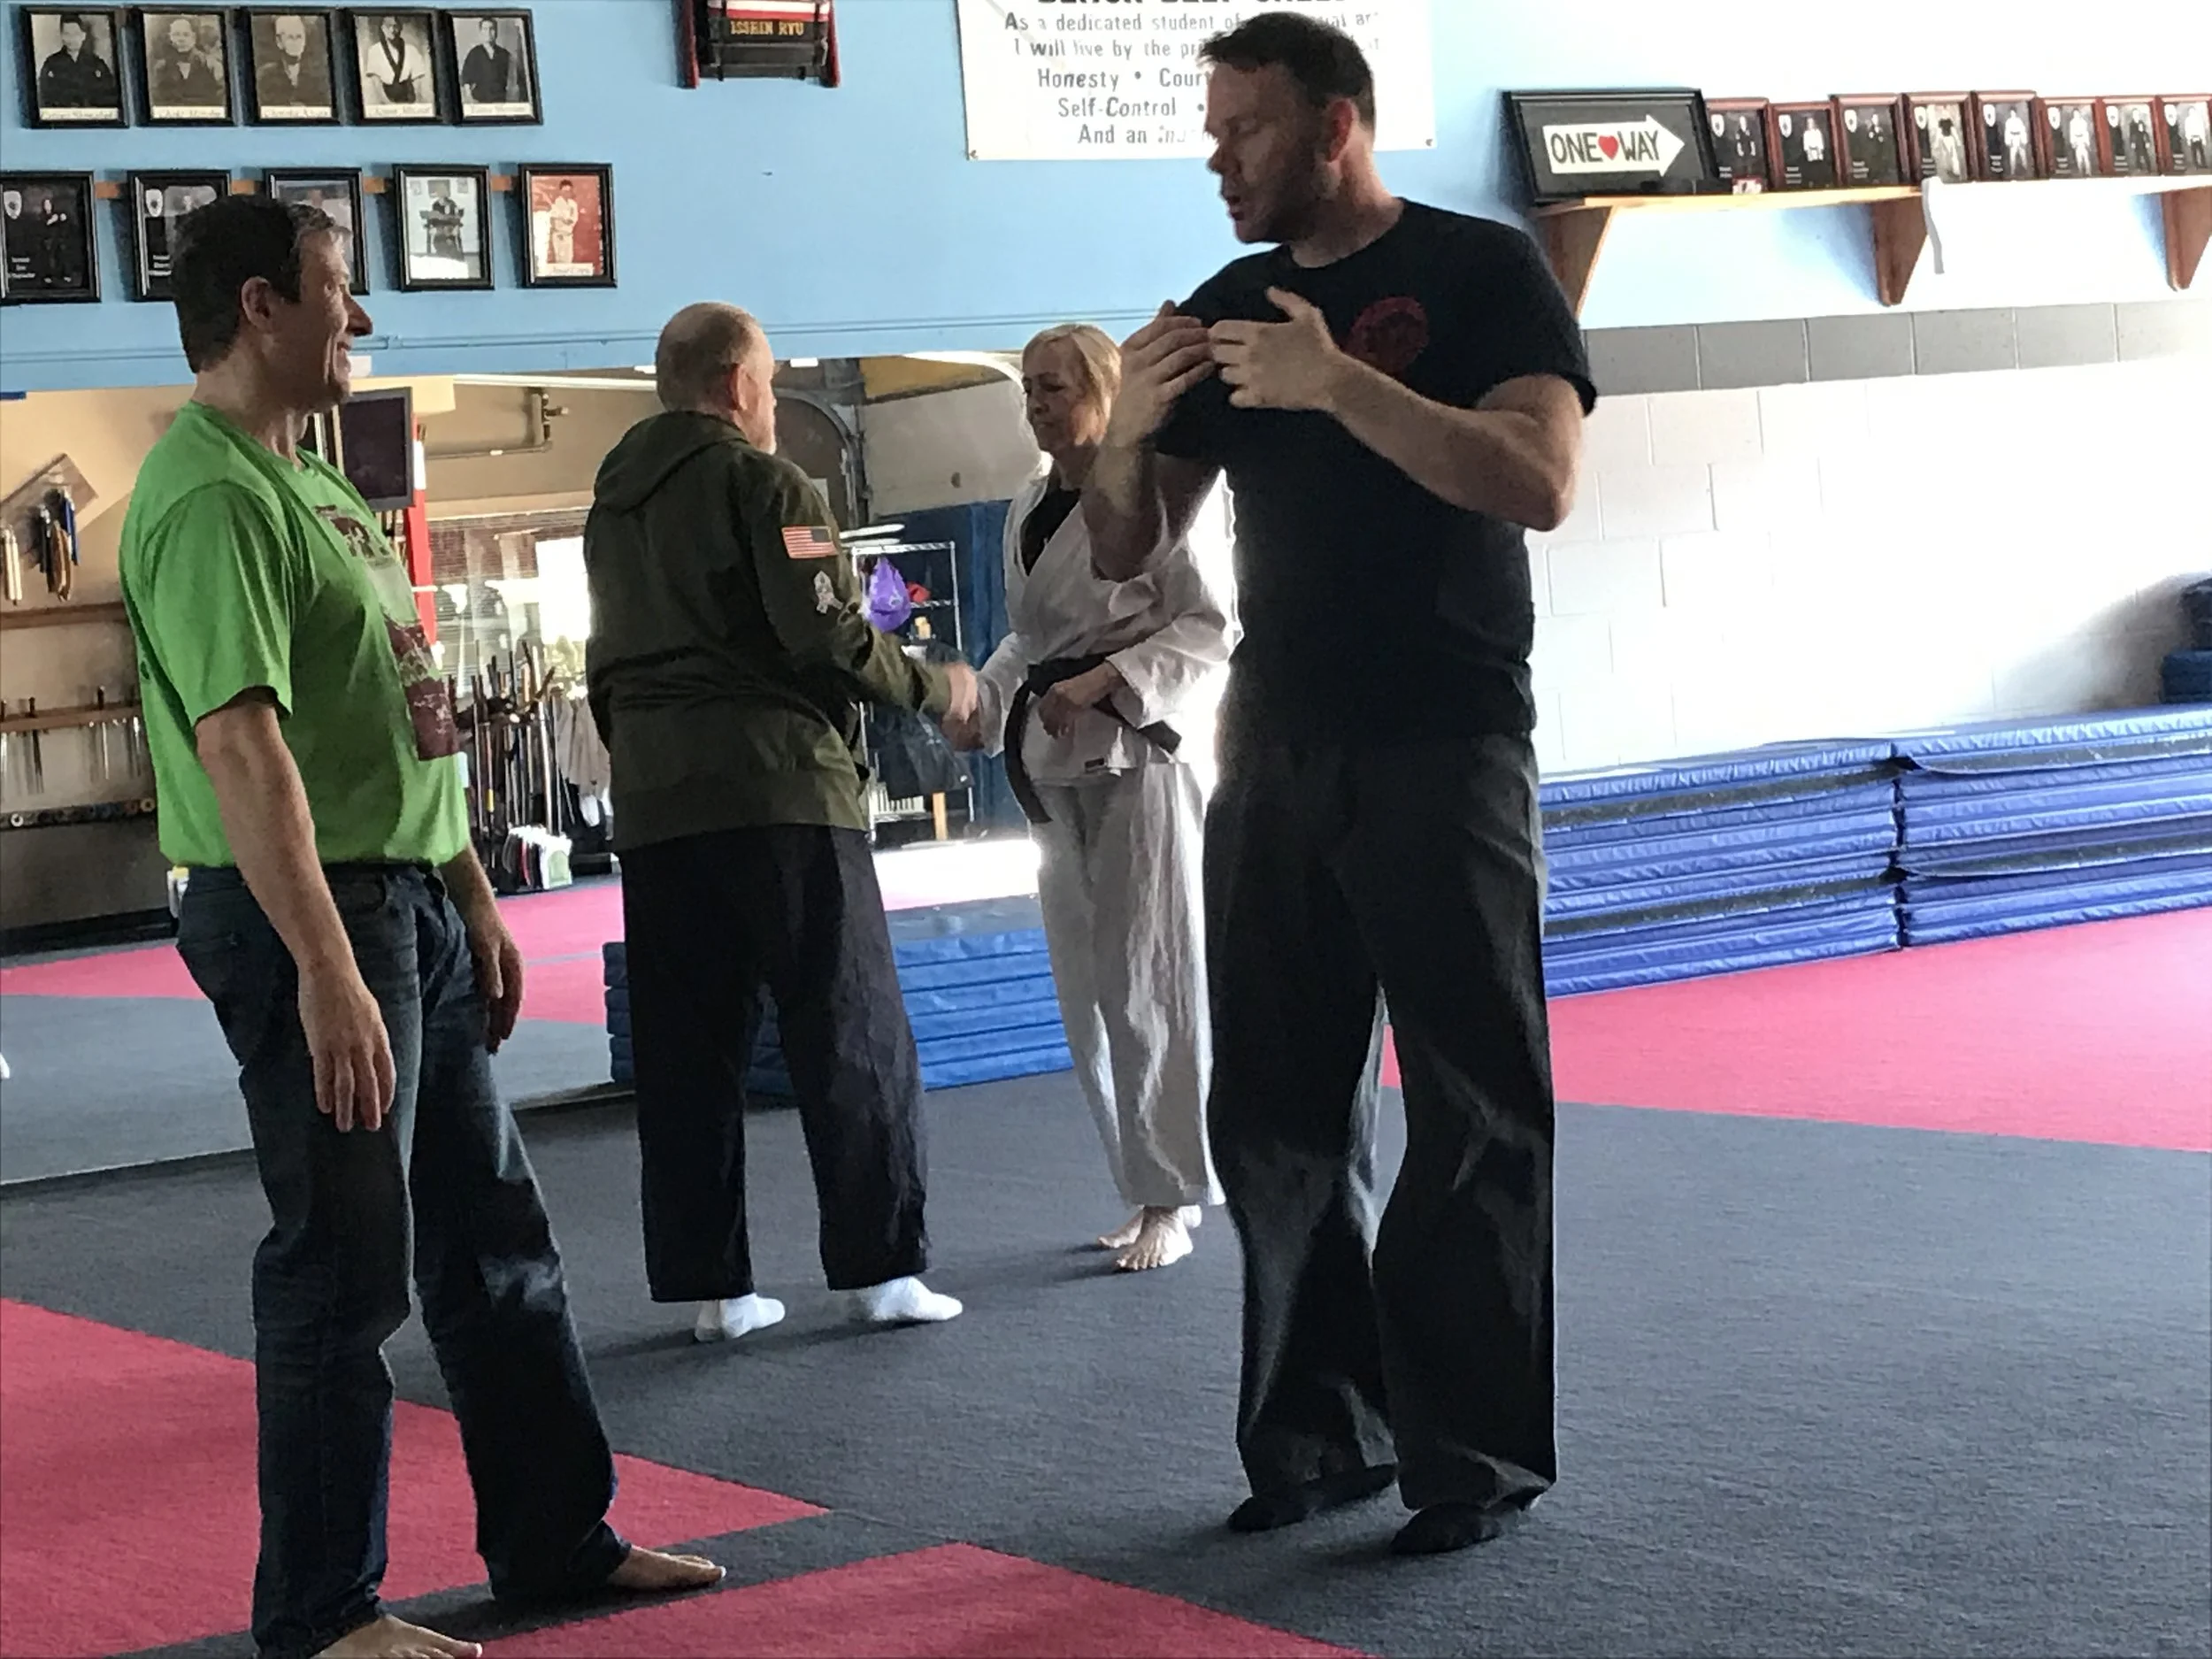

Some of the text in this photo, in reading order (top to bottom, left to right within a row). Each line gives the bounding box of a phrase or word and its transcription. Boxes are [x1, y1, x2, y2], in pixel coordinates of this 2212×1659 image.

[779, 21, 804, 35] RYU
[1004, 12, 1029, 32] As
[1056, 13, 1142, 31] dedicated
[1151, 13, 1215, 31] student
[1030, 39, 1066, 57] will
[1072, 39, 1103, 57] live
[1112, 39, 1133, 61] by
[1144, 39, 1171, 57] the
[1038, 67, 1119, 92] Honesty
[1058, 96, 1177, 118] Self-Control
[1078, 124, 1116, 144] And
[1126, 129, 1148, 144] an
[1550, 130, 1660, 164] ONE WAY
